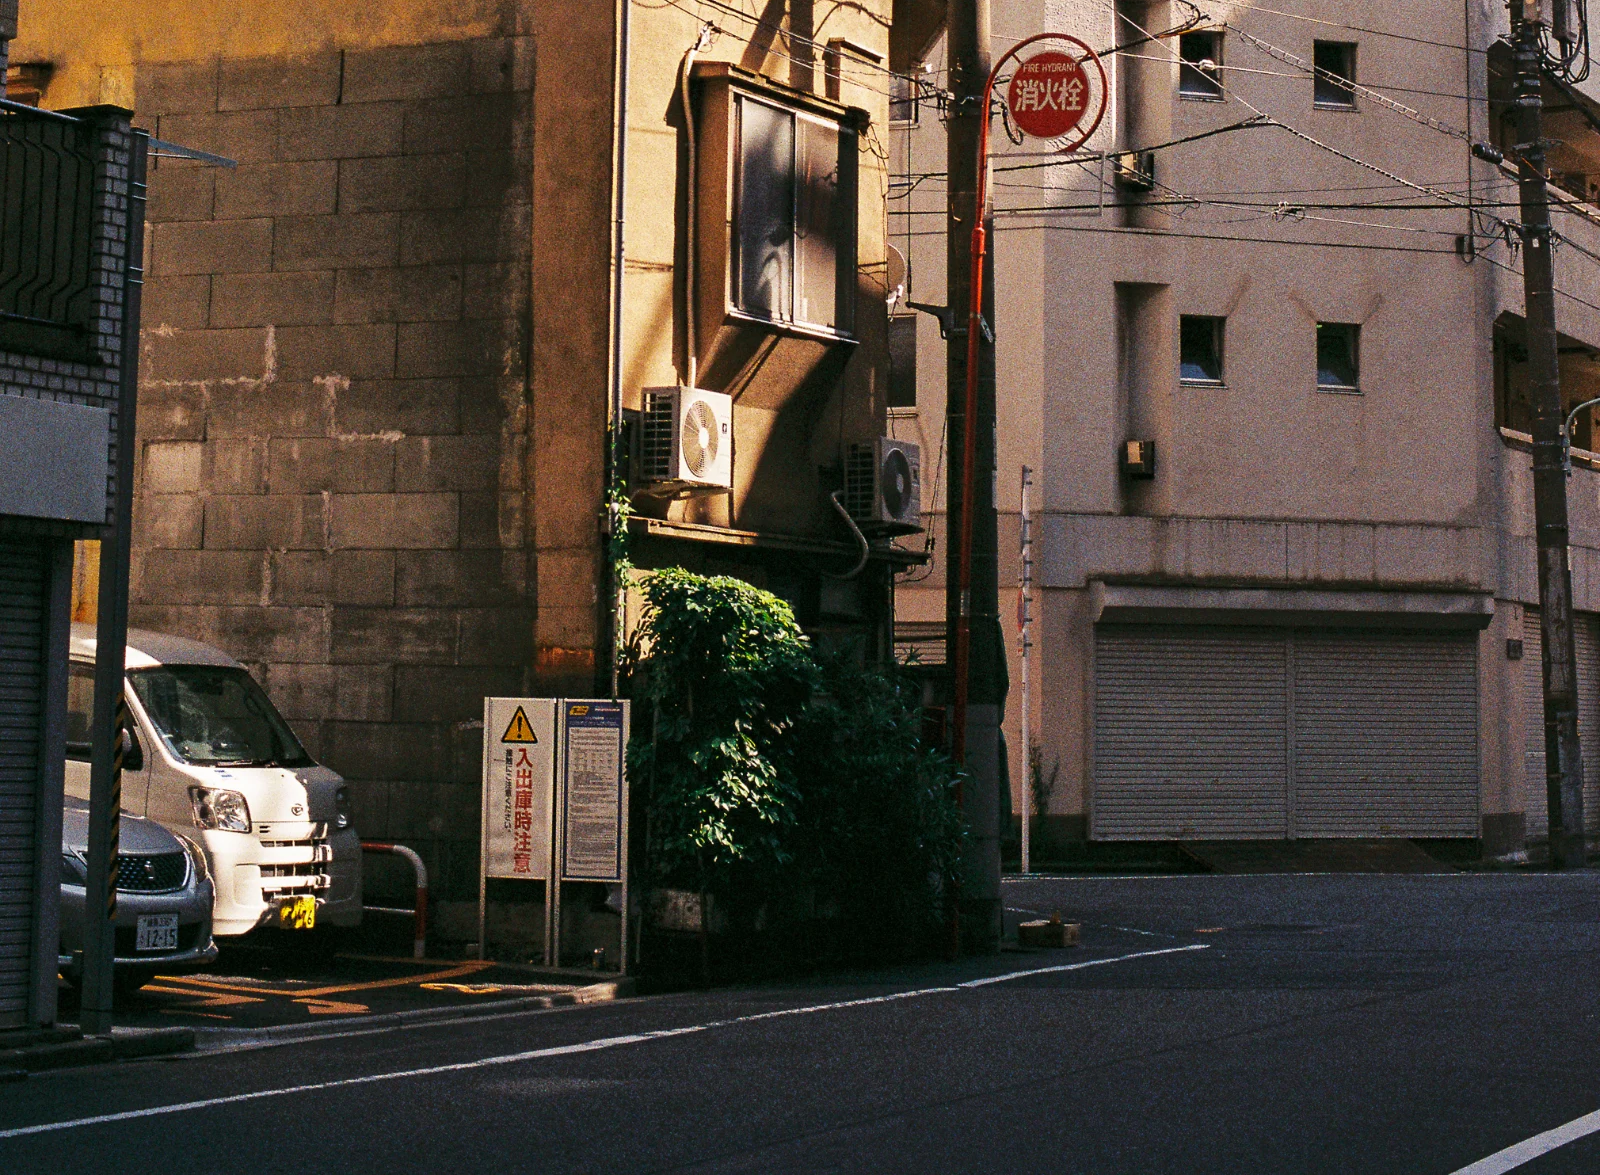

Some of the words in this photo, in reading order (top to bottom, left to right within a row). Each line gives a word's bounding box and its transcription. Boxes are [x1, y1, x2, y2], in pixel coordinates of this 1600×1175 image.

[1023, 63, 1039, 73] FIRE
[1042, 62, 1076, 73] HYDRANT
[1015, 77, 1083, 112] 消火栓
[513, 747, 533, 873] 入出庫時注意
